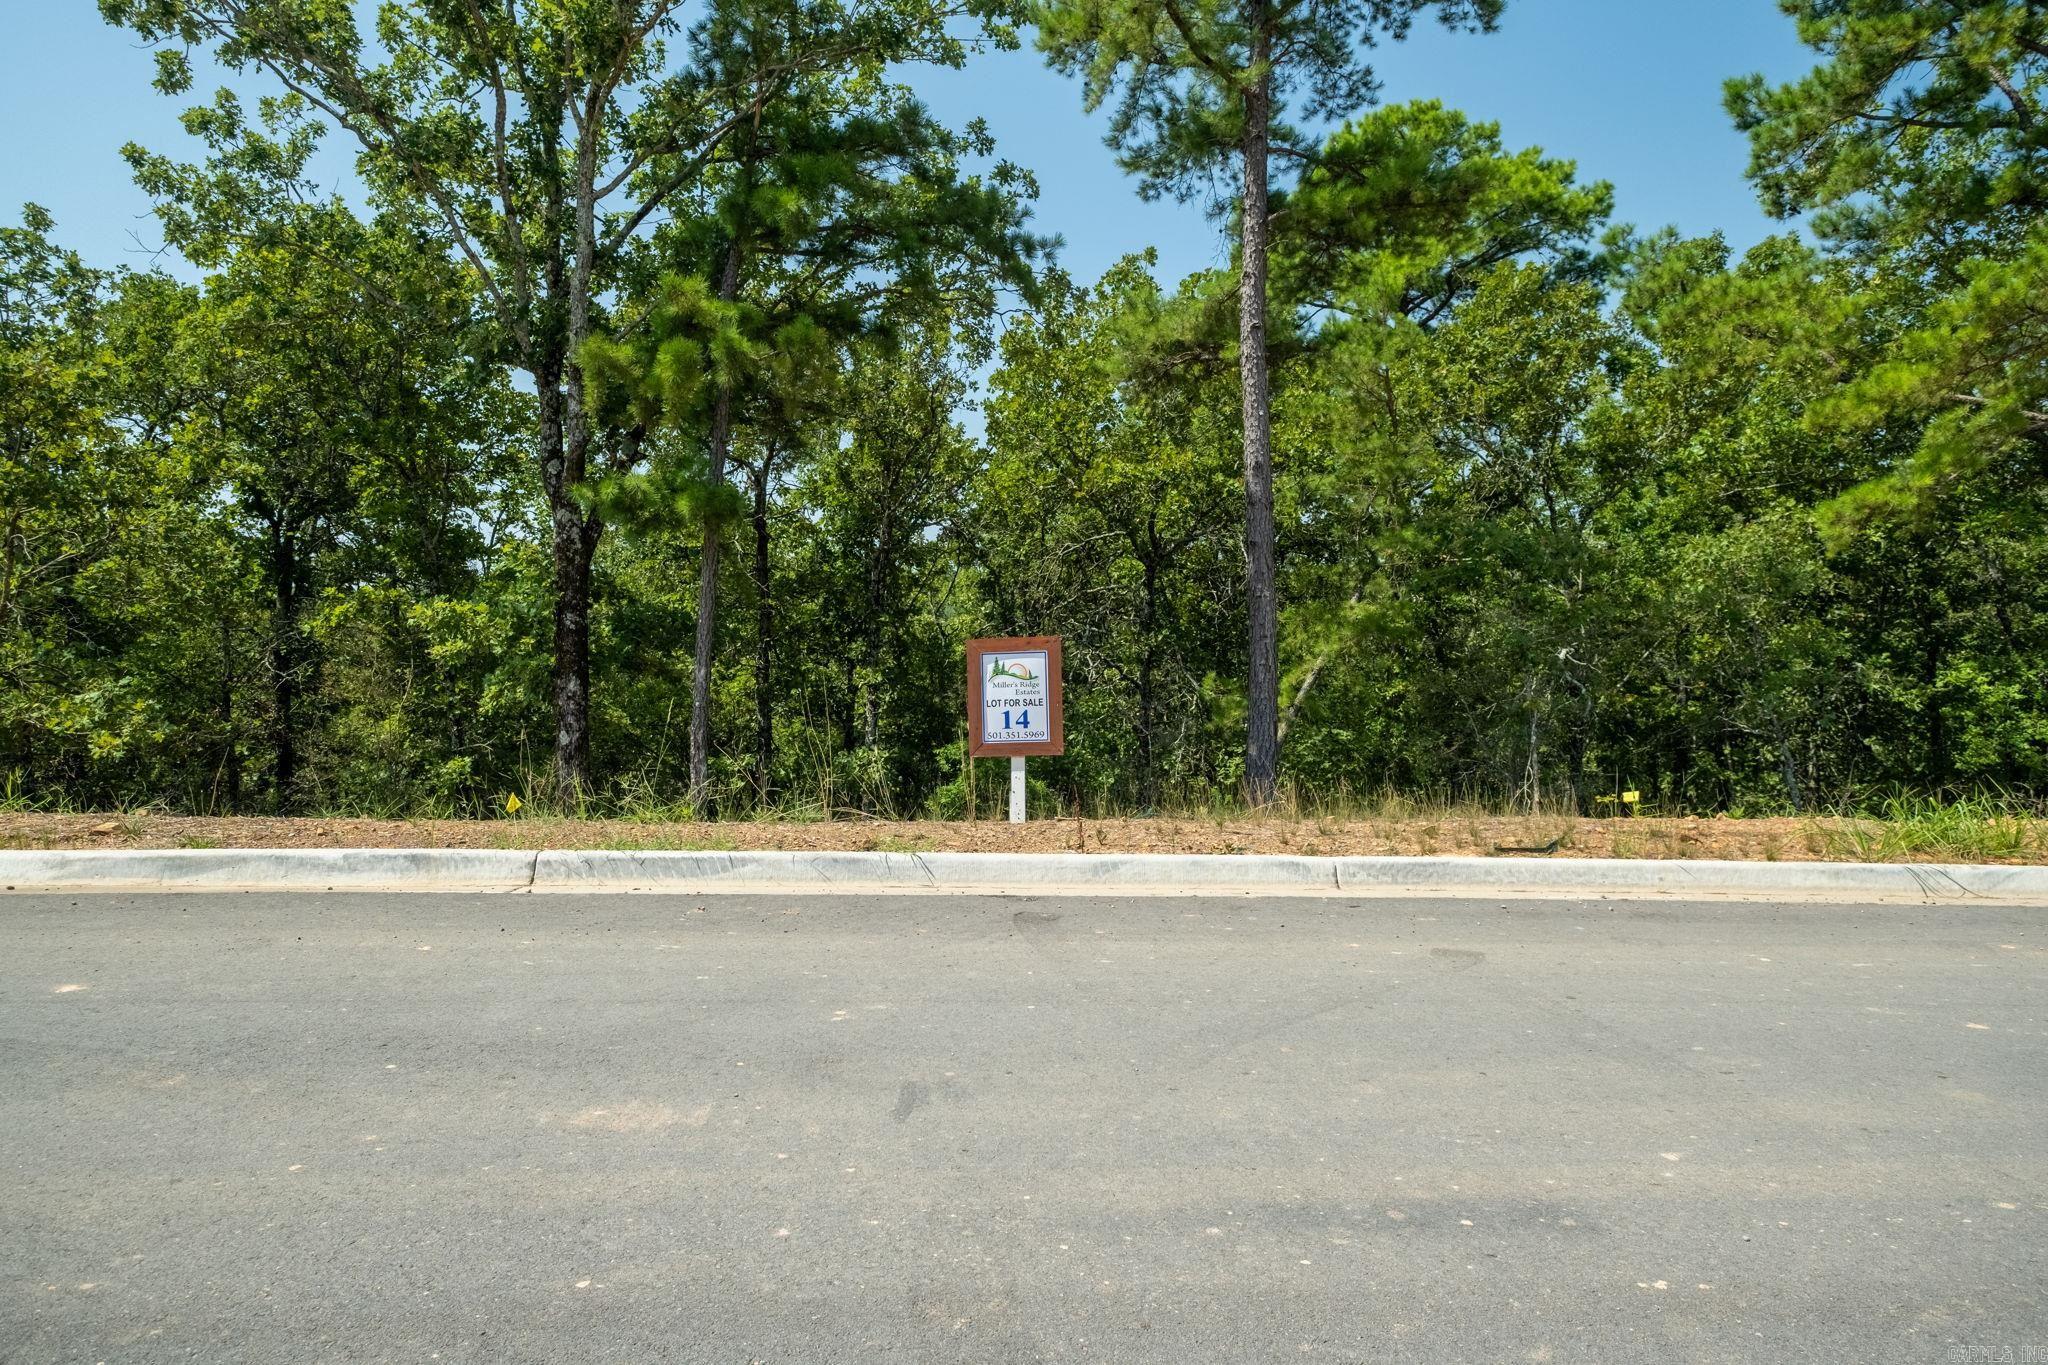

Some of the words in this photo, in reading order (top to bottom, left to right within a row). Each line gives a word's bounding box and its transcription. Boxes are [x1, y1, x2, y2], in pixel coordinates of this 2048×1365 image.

[1019, 681, 1040, 689] Ridge
[986, 699, 1002, 708] LOT
[1004, 699, 1020, 707] FOR
[1022, 698, 1044, 707] SALE
[1001, 709, 1030, 730] 14
[987, 731, 1045, 740] 501.351.5969
